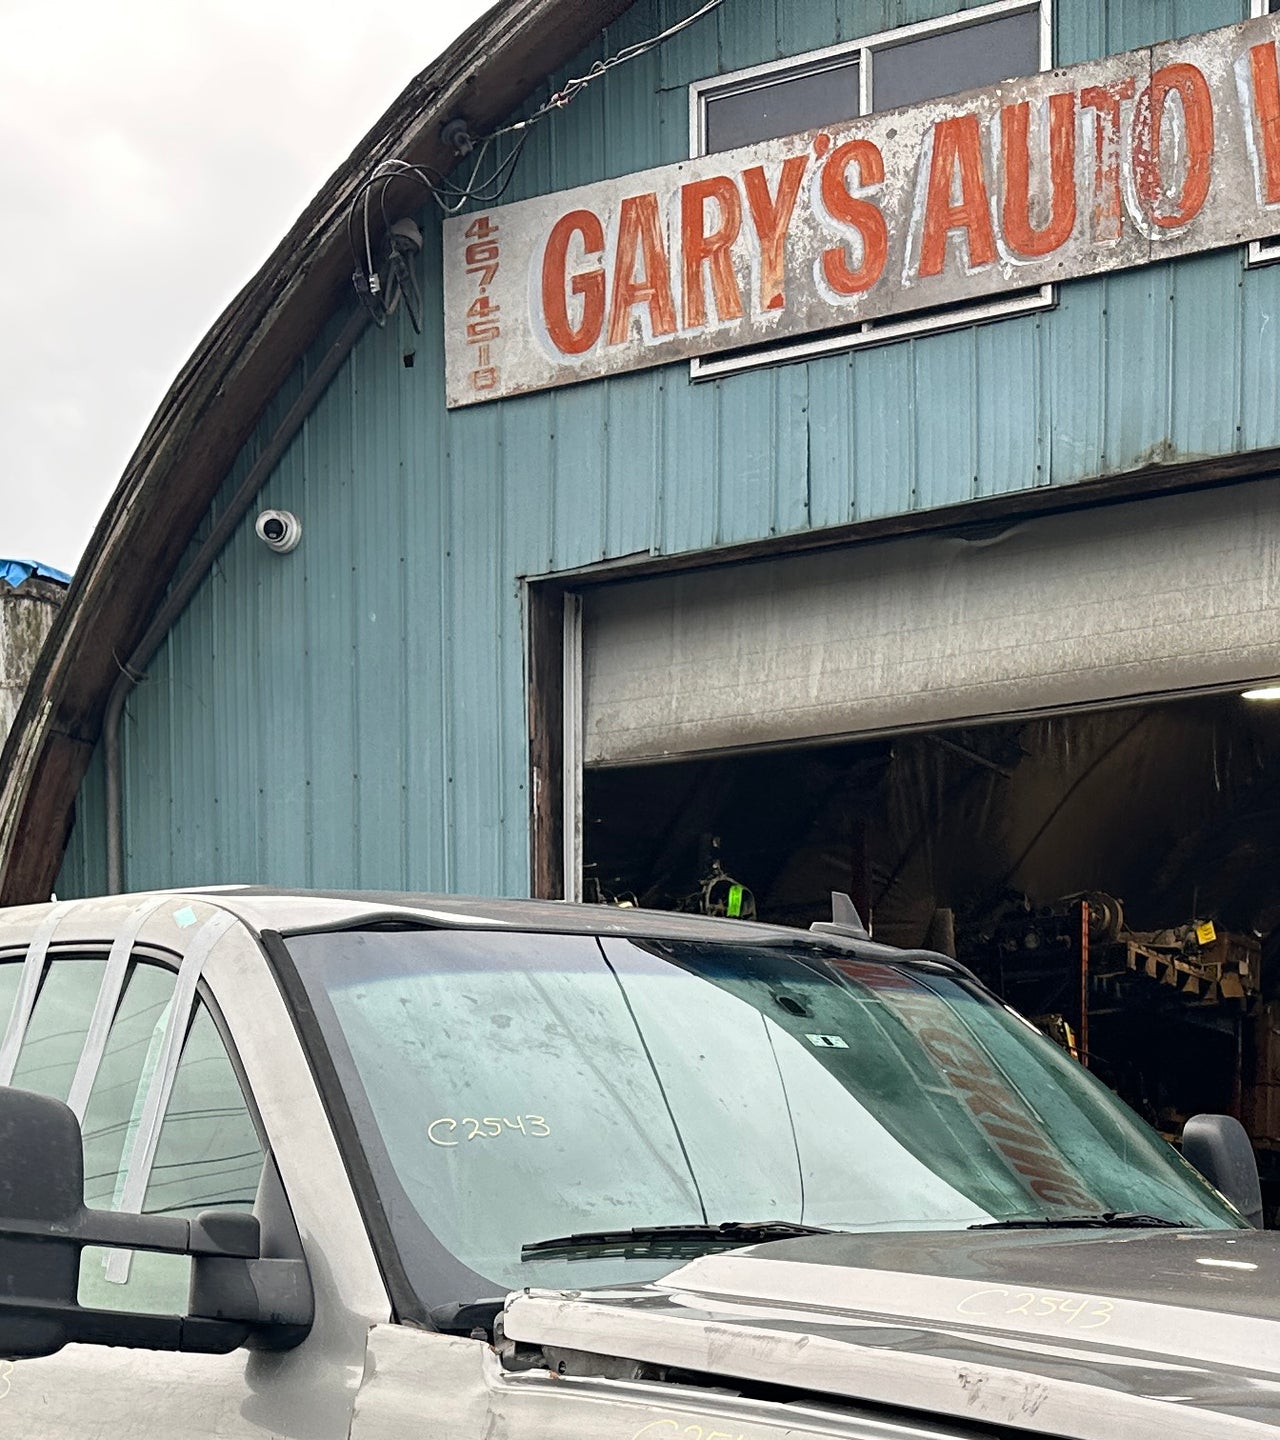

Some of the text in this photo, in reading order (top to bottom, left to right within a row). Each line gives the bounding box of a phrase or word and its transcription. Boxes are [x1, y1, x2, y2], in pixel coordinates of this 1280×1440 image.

[542, 133, 887, 354] GARY'S
[919, 63, 1213, 278] AUTO
[427, 1114, 551, 1146] C2543
[956, 1289, 1115, 1329] C2543
